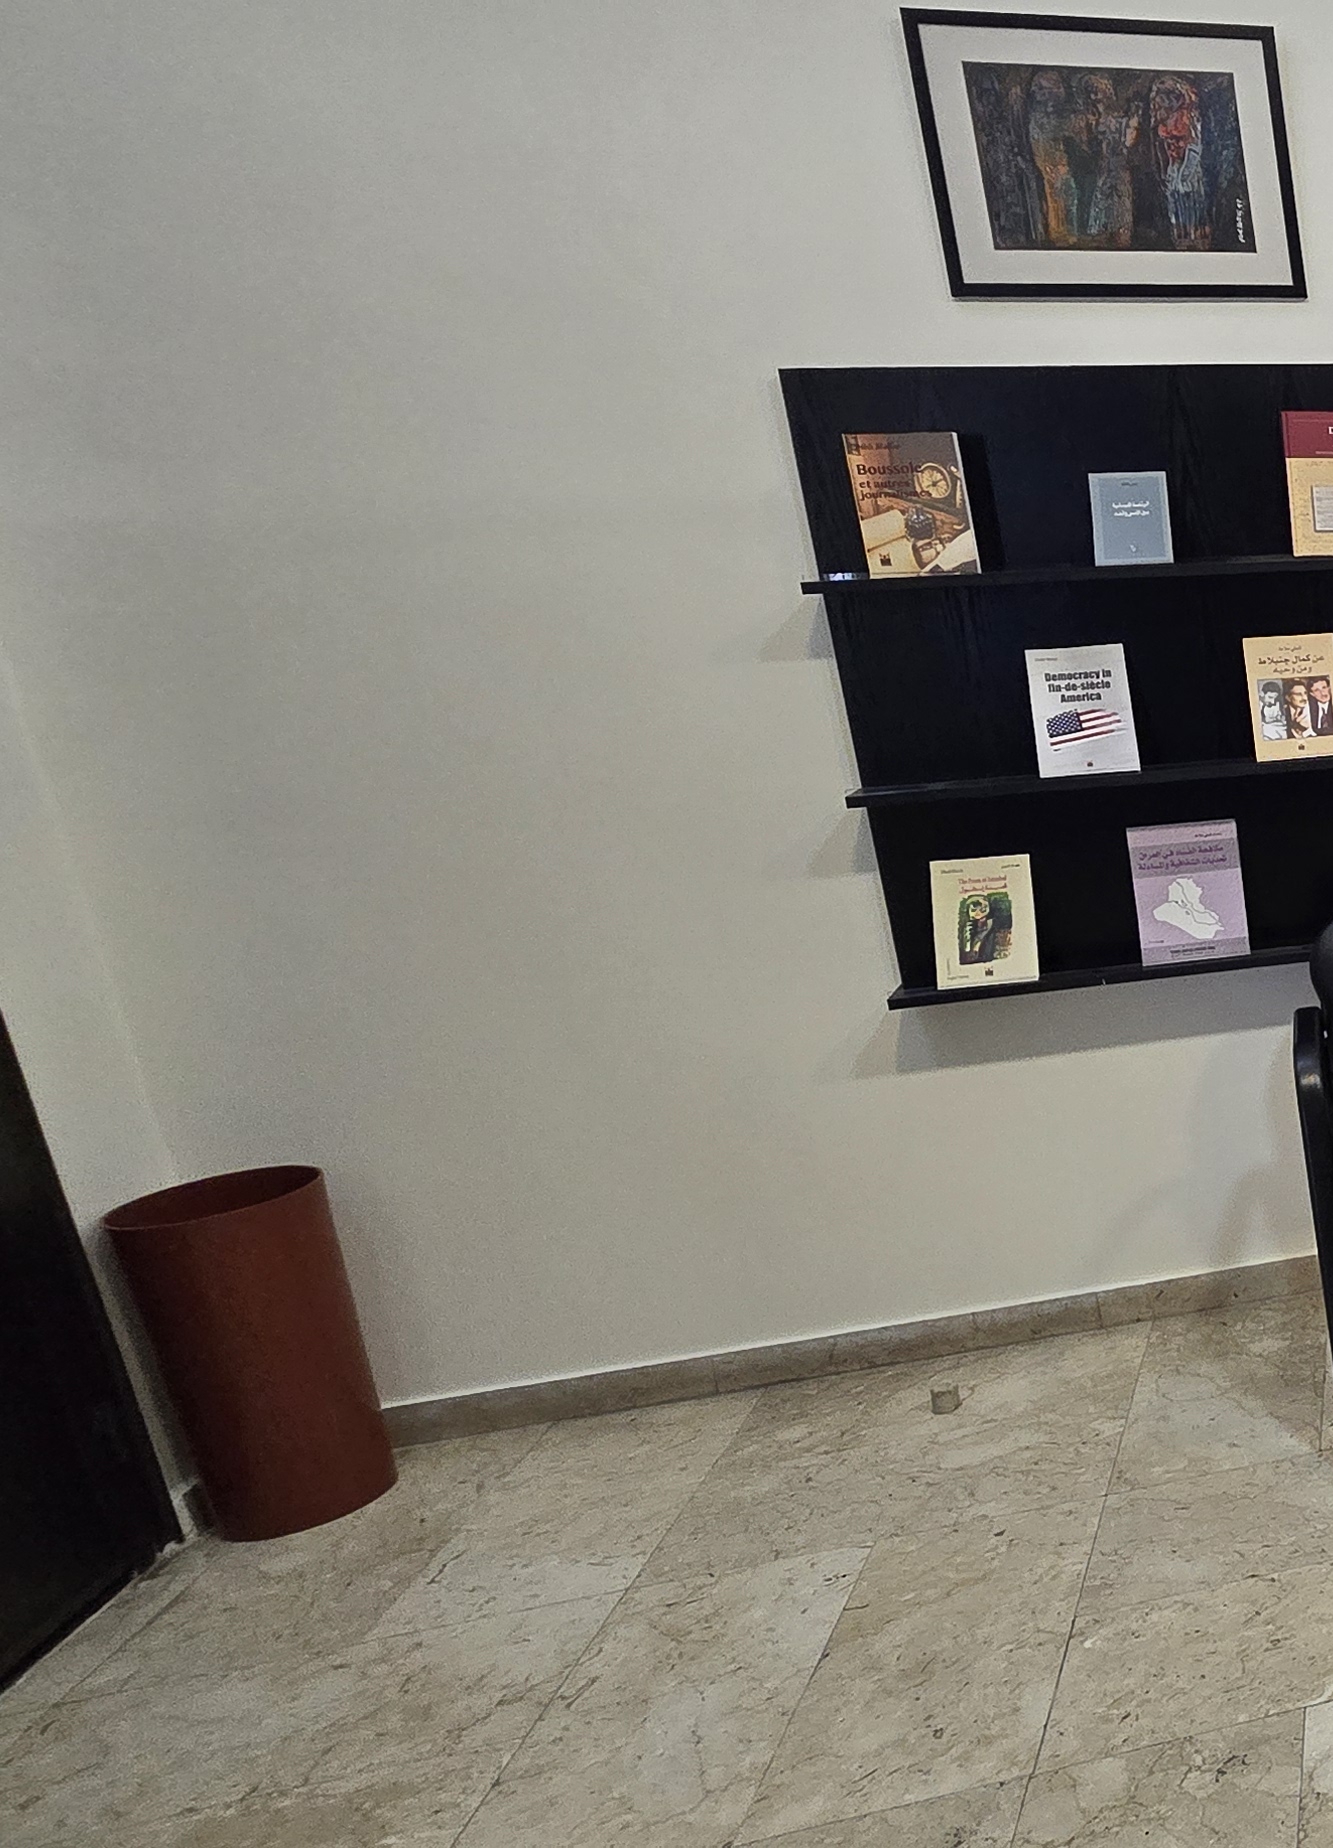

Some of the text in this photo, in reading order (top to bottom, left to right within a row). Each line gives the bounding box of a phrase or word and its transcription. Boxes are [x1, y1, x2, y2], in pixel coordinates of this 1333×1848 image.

[856, 461, 922, 475] Boussole
[859, 480, 871, 488] et
[1045, 669, 1112, 682] Democracy in
[1060, 692, 1102, 703] America
